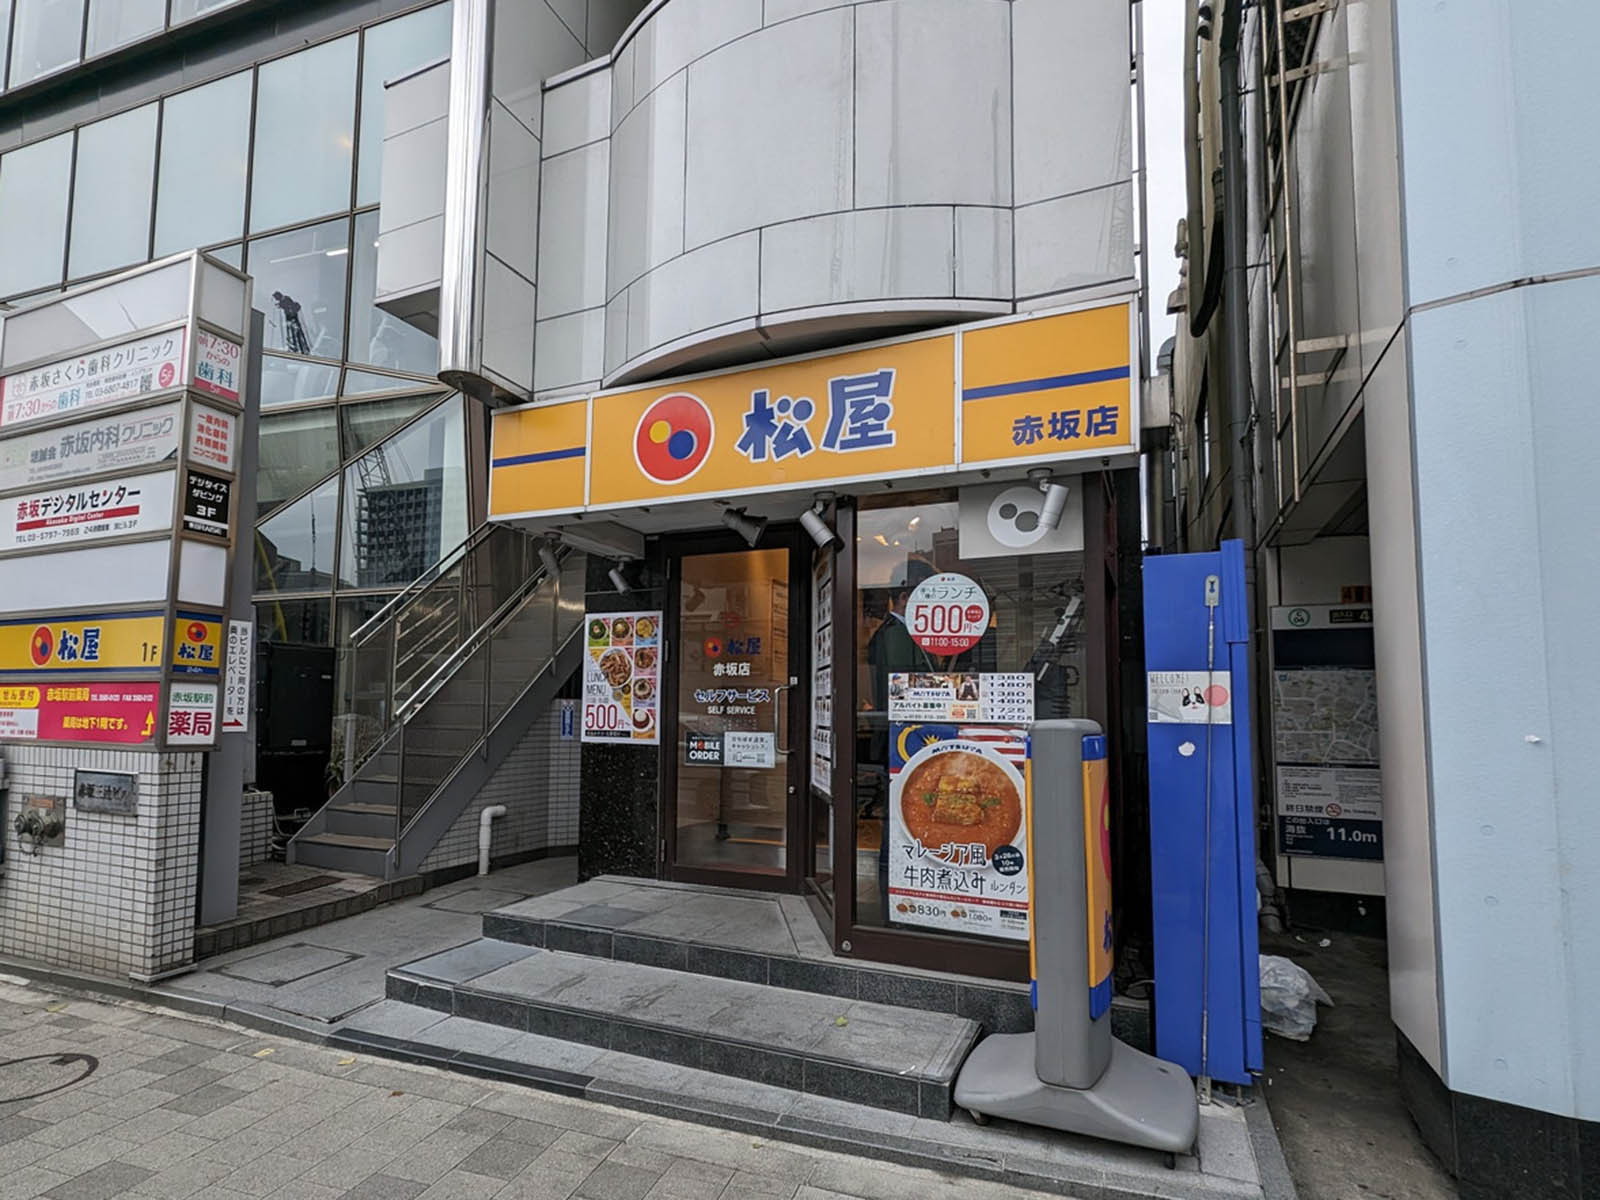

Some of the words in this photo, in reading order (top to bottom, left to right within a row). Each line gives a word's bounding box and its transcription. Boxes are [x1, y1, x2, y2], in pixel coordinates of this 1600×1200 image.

[29, 339, 174, 391] 赤坂さくら歯科クリニック
[197, 361, 233, 388] 歯科
[735, 367, 896, 464] 松屋
[1013, 405, 1119, 445] 赤坂店
[17, 485, 141, 521] 赤坂デジタルセンター
[192, 488, 224, 503] ダビング
[196, 504, 217, 518] 3F
[57, 628, 101, 662] 松屋
[141, 641, 158, 662] 1F
[178, 642, 215, 662] 松屋
[727, 636, 761, 655] 松屋
[713, 662, 751, 676] 赤坂店
[171, 691, 215, 705] 赤坂駅前
[586, 684, 607, 696] MENU
[694, 688, 771, 703] セルフサービス
[707, 705, 724, 715] SELF
[727, 705, 756, 715] SERVICE
[168, 710, 213, 737] 薬局
[689, 750, 720, 761] ORDER
[931, 743, 983, 755] MATSUYA
[1326, 826, 1378, 843] 11.0m
[901, 839, 987, 867] マレーシア風
[904, 864, 987, 895] 牛肉煮込み
